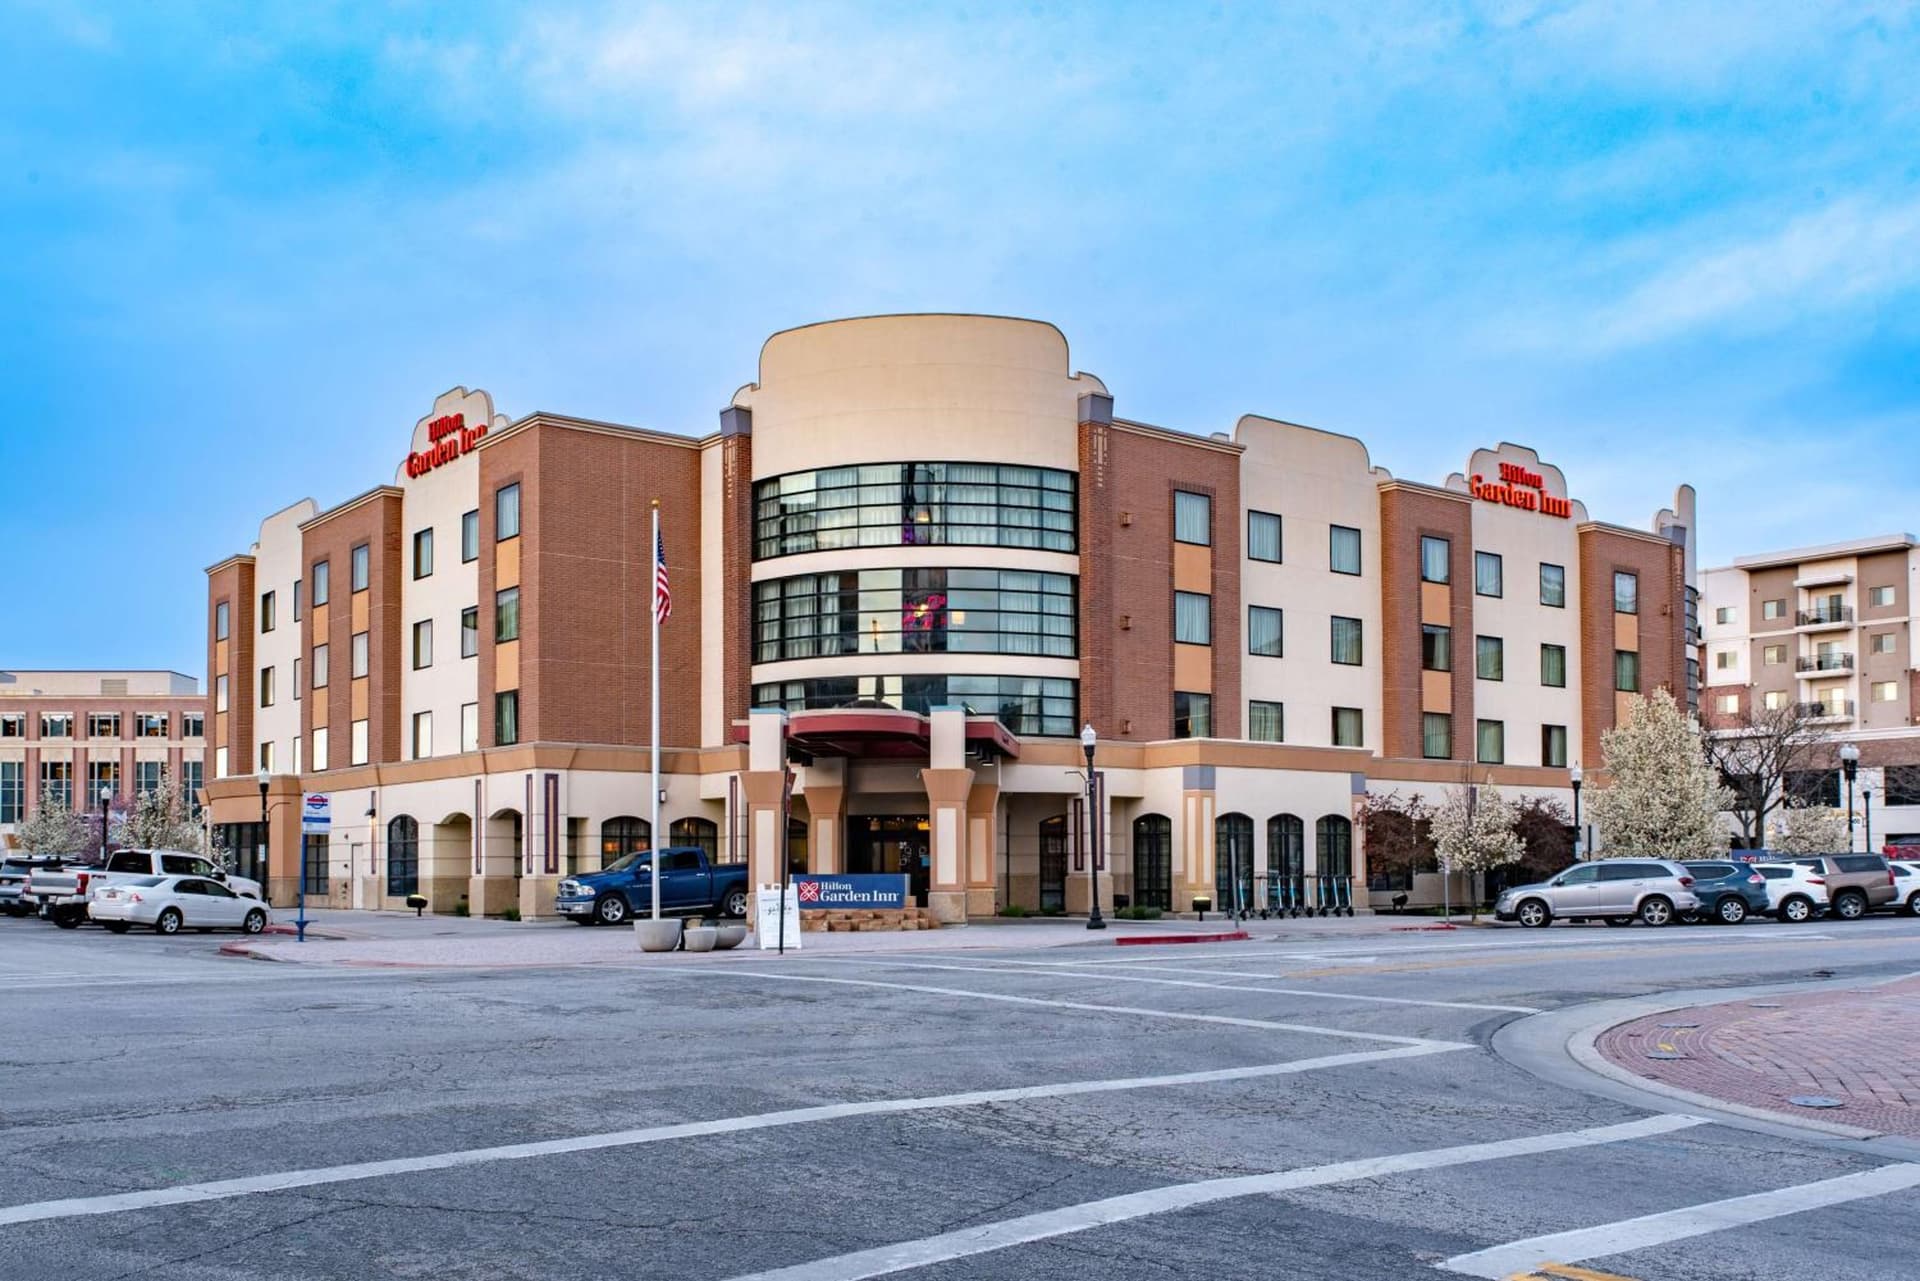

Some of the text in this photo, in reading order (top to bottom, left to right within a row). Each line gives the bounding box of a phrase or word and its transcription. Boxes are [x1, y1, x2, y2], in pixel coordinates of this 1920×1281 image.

[428, 412, 465, 443] Hilton
[406, 438, 459, 479] Garden
[1499, 462, 1543, 489] Hilton
[1471, 474, 1573, 519] Garden Inn
[820, 889, 898, 902] Garden Inn
[821, 881, 852, 891] Hilton
